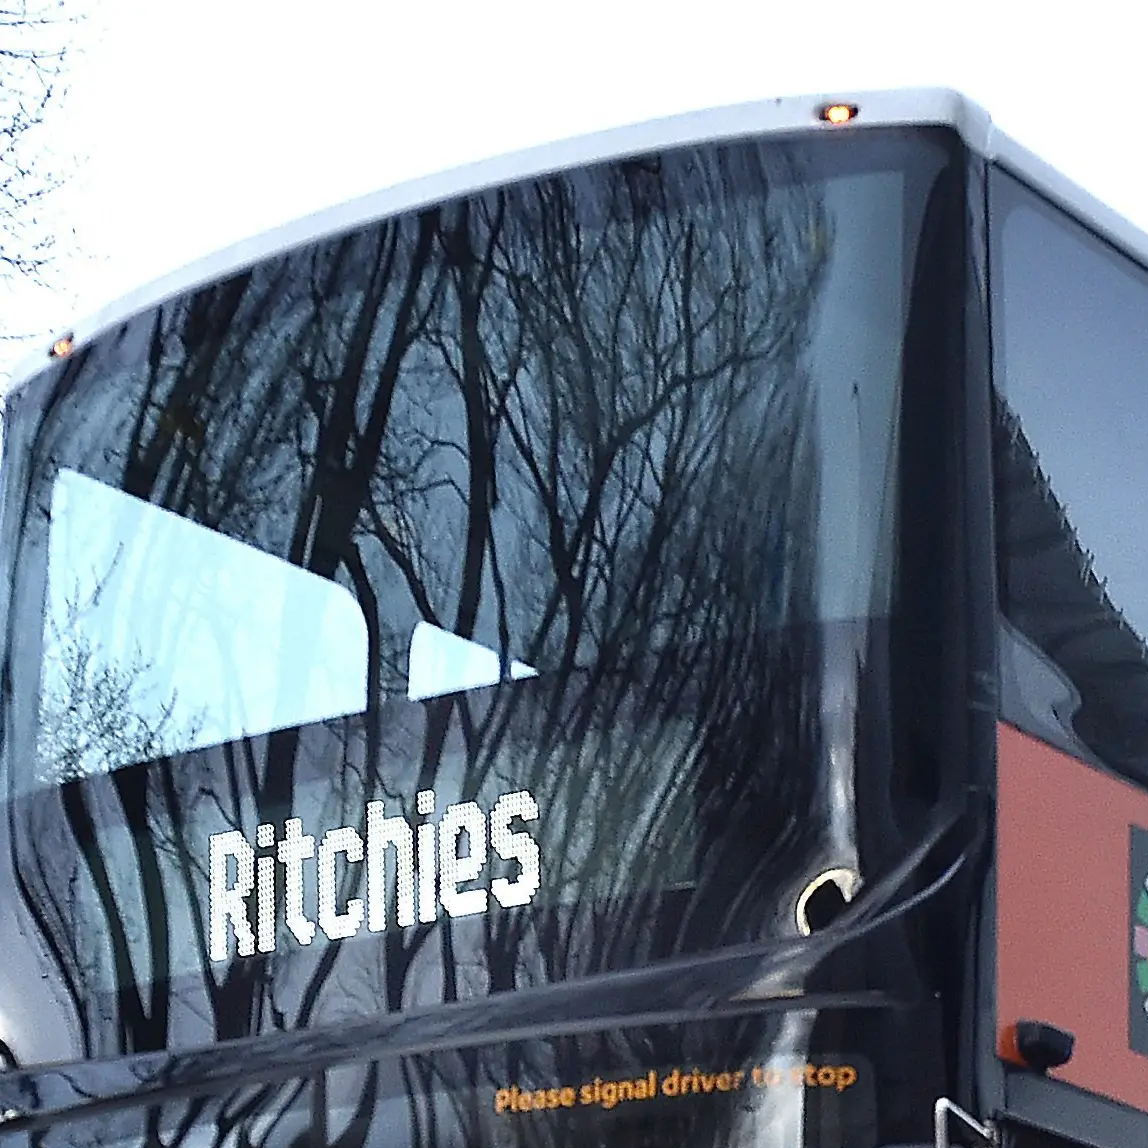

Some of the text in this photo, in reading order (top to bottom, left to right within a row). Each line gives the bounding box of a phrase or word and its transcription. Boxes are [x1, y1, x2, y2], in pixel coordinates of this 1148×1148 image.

[208, 789, 541, 962] Ritchies
[494, 1084, 576, 1113] Please
[579, 1068, 658, 1109] signal
[661, 1066, 744, 1097] driver
[790, 1062, 857, 1092] stop
